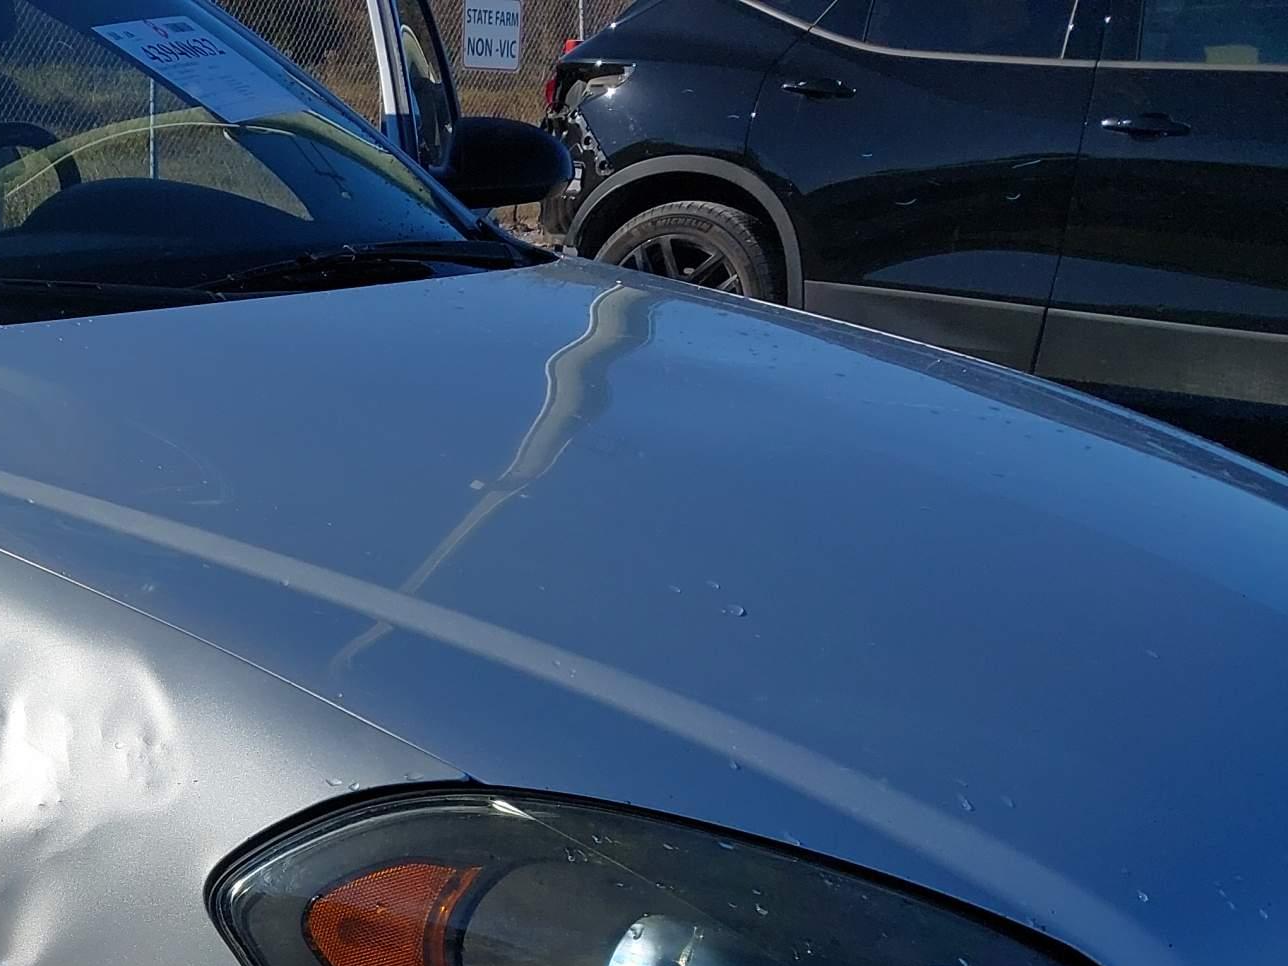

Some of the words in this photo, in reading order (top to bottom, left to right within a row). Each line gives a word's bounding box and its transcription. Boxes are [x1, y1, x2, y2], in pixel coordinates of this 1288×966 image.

[467, 8, 493, 25] STATE
[495, 10, 519, 27] FARM
[140, 38, 226, 63] 43940632
[467, 37, 493, 57] NON
